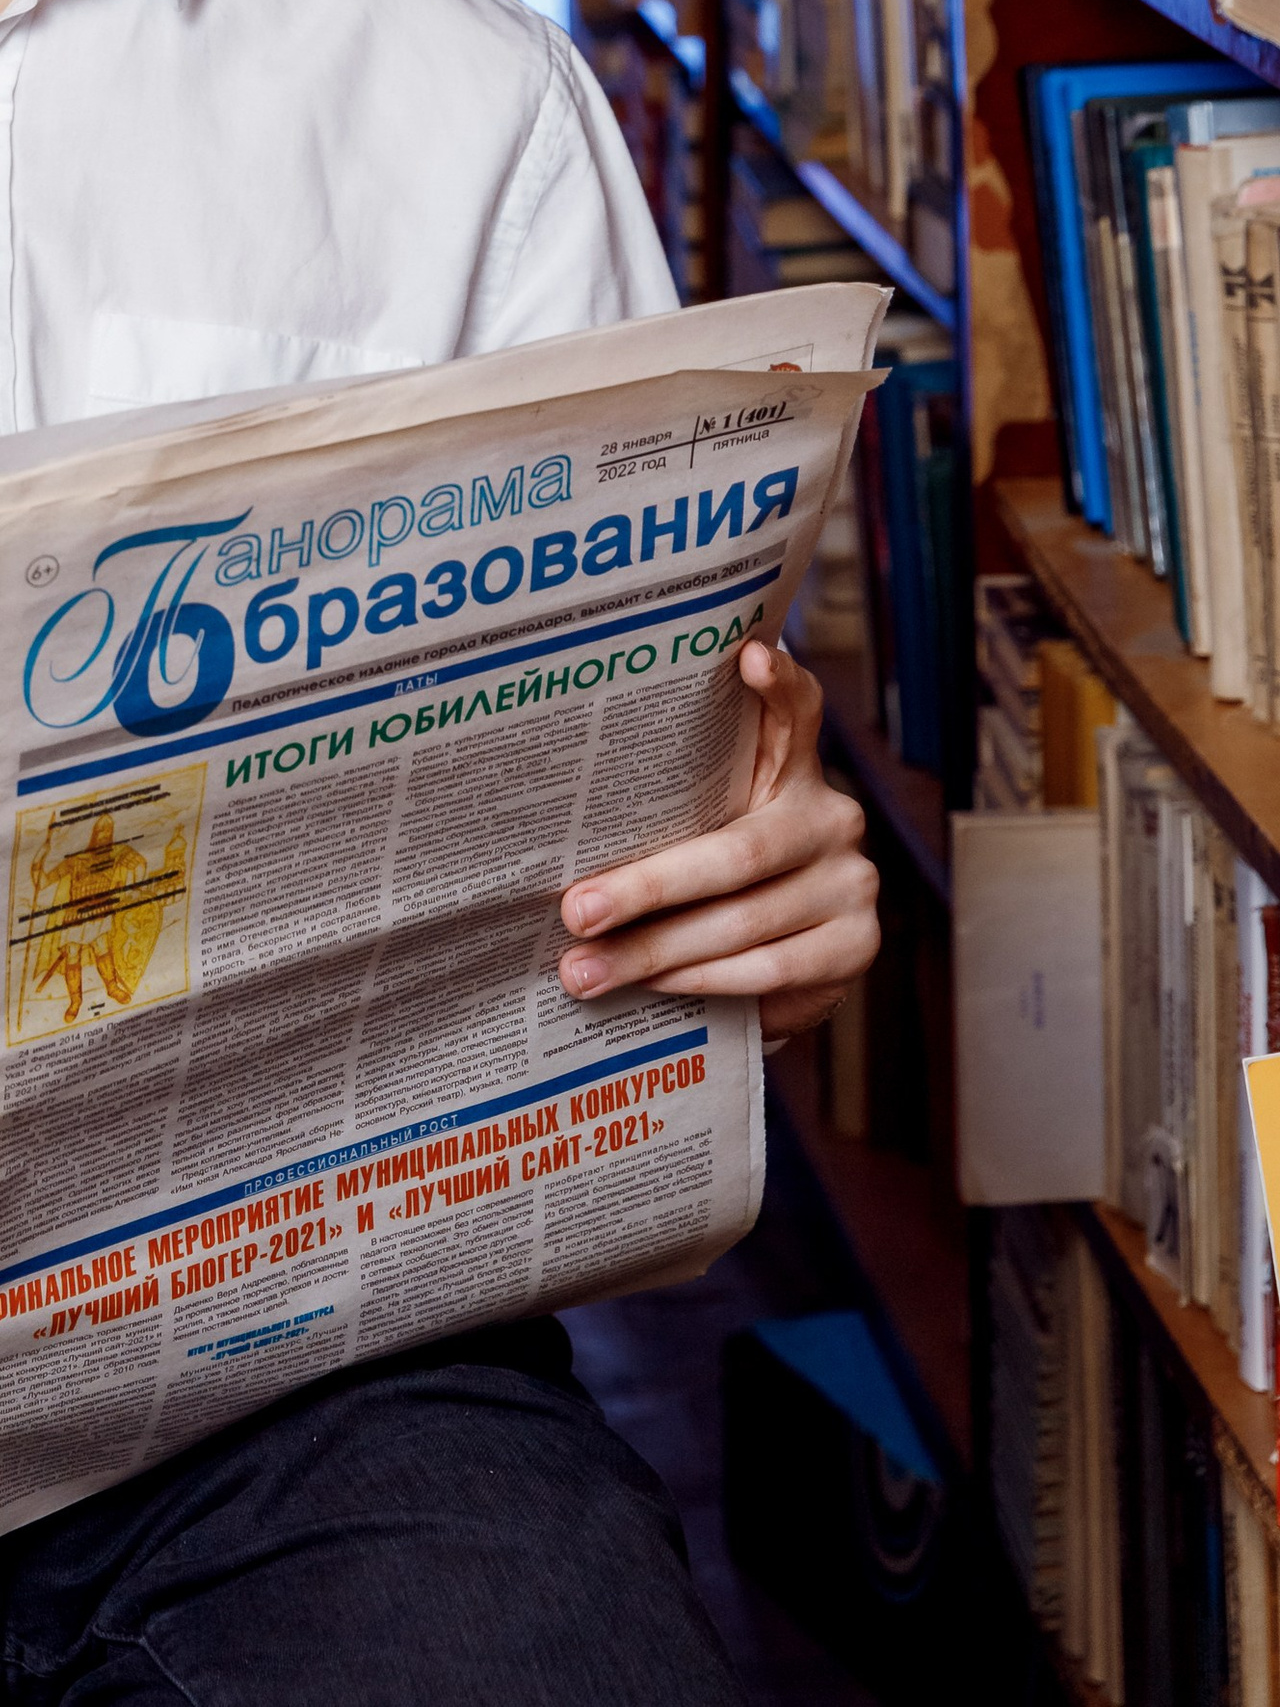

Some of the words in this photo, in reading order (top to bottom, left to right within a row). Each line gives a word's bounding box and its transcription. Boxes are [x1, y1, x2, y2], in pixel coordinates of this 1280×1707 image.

[600, 441, 617, 456] 28
[622, 431, 672, 450] января
[699, 415, 717, 435] №
[723, 413, 732, 430] 1
[737, 401, 787, 428] (401)
[712, 429, 769, 450] пятница
[598, 461, 636, 482] 2022
[641, 456, 666, 471] год
[23, 454, 573, 729] Панорама
[112, 466, 800, 737] Образования
[232, 672, 354, 711] Педагогическое
[359, 654, 419, 678] издание
[423, 638, 476, 660] города
[480, 612, 575, 644] Краснодара,
[580, 593, 641, 617] выходит
[644, 590, 652, 599] с
[656, 572, 717, 597] декабря
[720, 559, 749, 578] 2001
[752, 557, 761, 566] г.
[226, 727, 353, 787] ИТОГИ
[369, 644, 656, 748] ЮБИЛЕЙНОГО
[671, 603, 763, 663] ГОДА
[394, 672, 438, 696] ДАТЫ
[453, 726, 504, 745] культурном
[507, 714, 550, 729] наследии
[553, 703, 584, 717] России
[201, 947, 212, 955] во
[216, 939, 234, 950] имя
[239, 922, 289, 943] Отечества
[303, 906, 337, 922] народа.
[345, 894, 380, 909] Любовь
[211, 948, 240, 963] отвага,
[247, 927, 306, 951] бескорыстие
[320, 904, 380, 928] сострадание,
[543, 1029, 603, 1058] православной
[605, 1024, 653, 1046] директора
[652, 1015, 681, 1029] школы
[148, 1180, 323, 1268] МЕРОПРИЯТИЕ
[336, 1103, 563, 1201] МУНИЦИПАЛЬНЫХ
[570, 1054, 704, 1125] КОНКУРСОВ
[243, 1123, 414, 1197] ПРОФЕССИОНАЛЬНЫЙ
[420, 1114, 459, 1134] РОСТ
[33, 1274, 158, 1339] «ЛУЧШИЙ
[171, 1217, 341, 1299] БЛОГЕР-2021»
[357, 1201, 374, 1233] И
[389, 1159, 509, 1219] «ЛУЧШИЙ
[522, 1111, 663, 1180] САЙТ-2021»
[370, 1237, 377, 1246] В
[379, 1224, 425, 1243] настоящее
[427, 1215, 453, 1228] время
[455, 1208, 473, 1221] рост
[475, 1188, 533, 1212] современного
[173, 1296, 213, 1315] Дьяченко
[216, 1287, 237, 1299] Вера
[291, 1248, 348, 1272] поблагодарив
[21, 1347, 40, 1357] году
[42, 1334, 93, 1351] состоялась
[96, 1313, 162, 1336] торжественная
